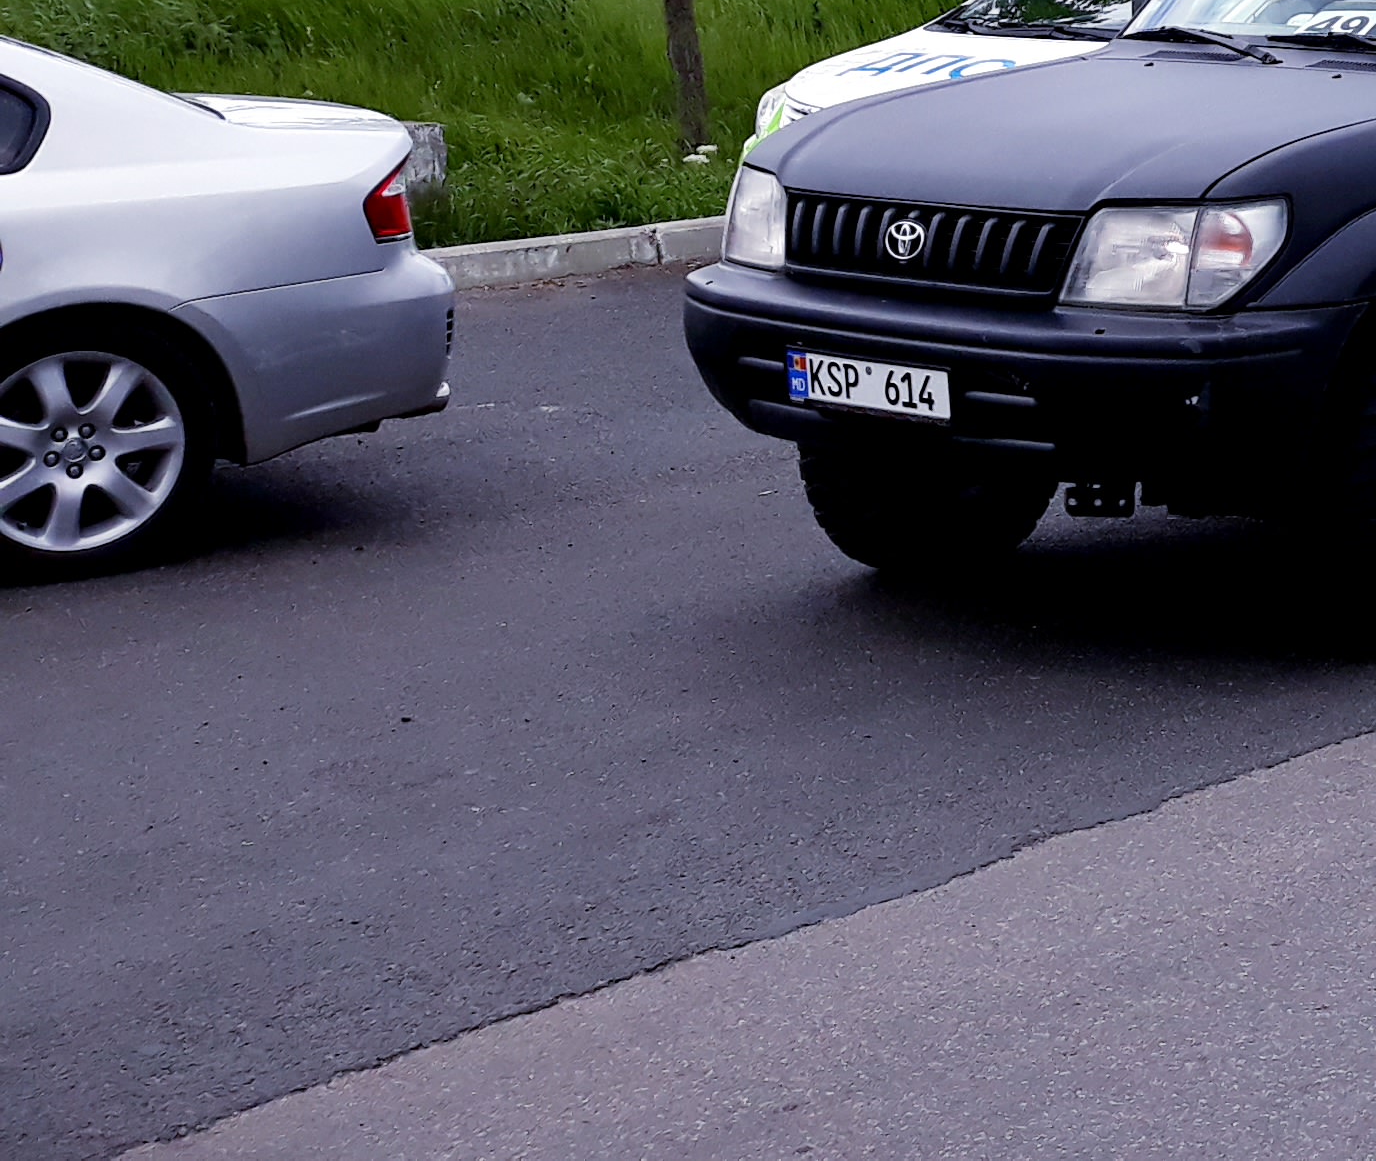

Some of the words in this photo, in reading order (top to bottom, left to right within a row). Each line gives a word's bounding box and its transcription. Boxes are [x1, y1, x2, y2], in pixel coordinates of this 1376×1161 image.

[1303, 15, 1370, 34] 49
[791, 376, 807, 392] MD
[808, 357, 860, 400] KSP
[884, 369, 936, 412] 614
